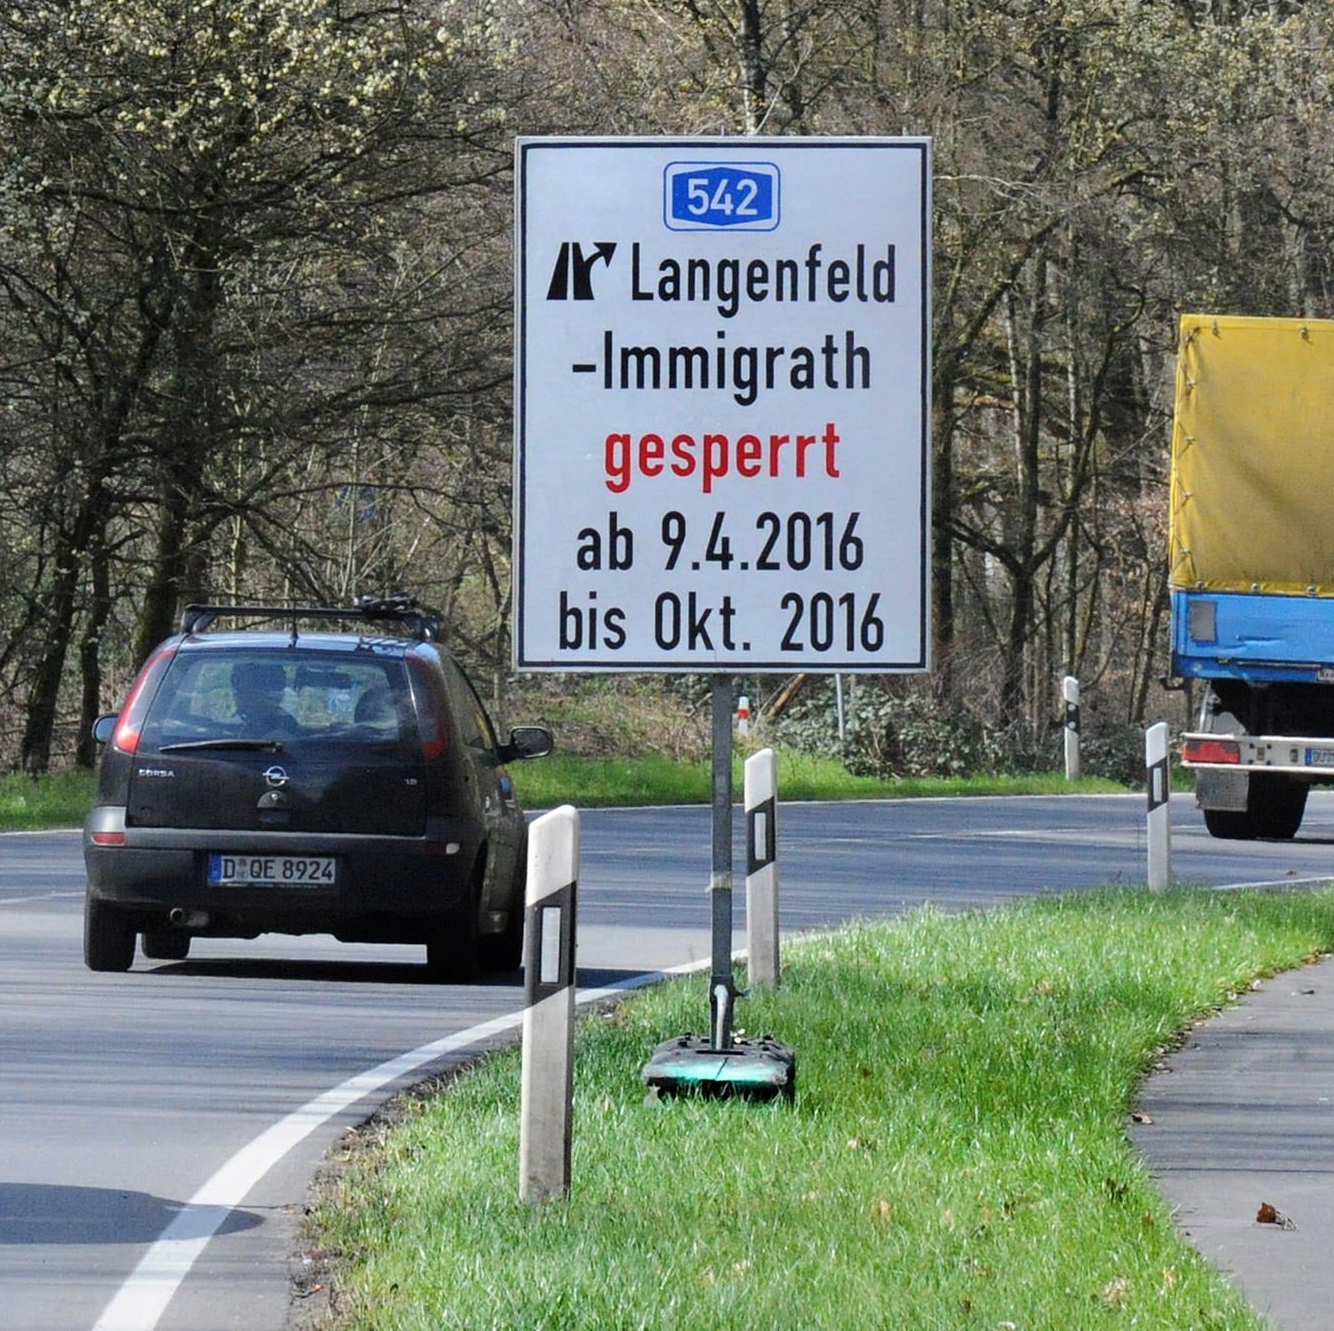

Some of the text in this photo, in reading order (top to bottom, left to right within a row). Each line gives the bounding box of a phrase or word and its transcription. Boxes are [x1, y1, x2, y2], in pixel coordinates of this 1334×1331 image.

[688, 178, 758, 215] 542
[631, 242, 896, 319] Langenfeld
[572, 330, 870, 407] -Immigrath
[605, 423, 841, 494] gesperrt
[576, 510, 864, 571] ab 9.4.2016
[559, 590, 884, 653] bis Okt. 2016
[223, 858, 235, 879] D
[282, 860, 334, 881] 8924
